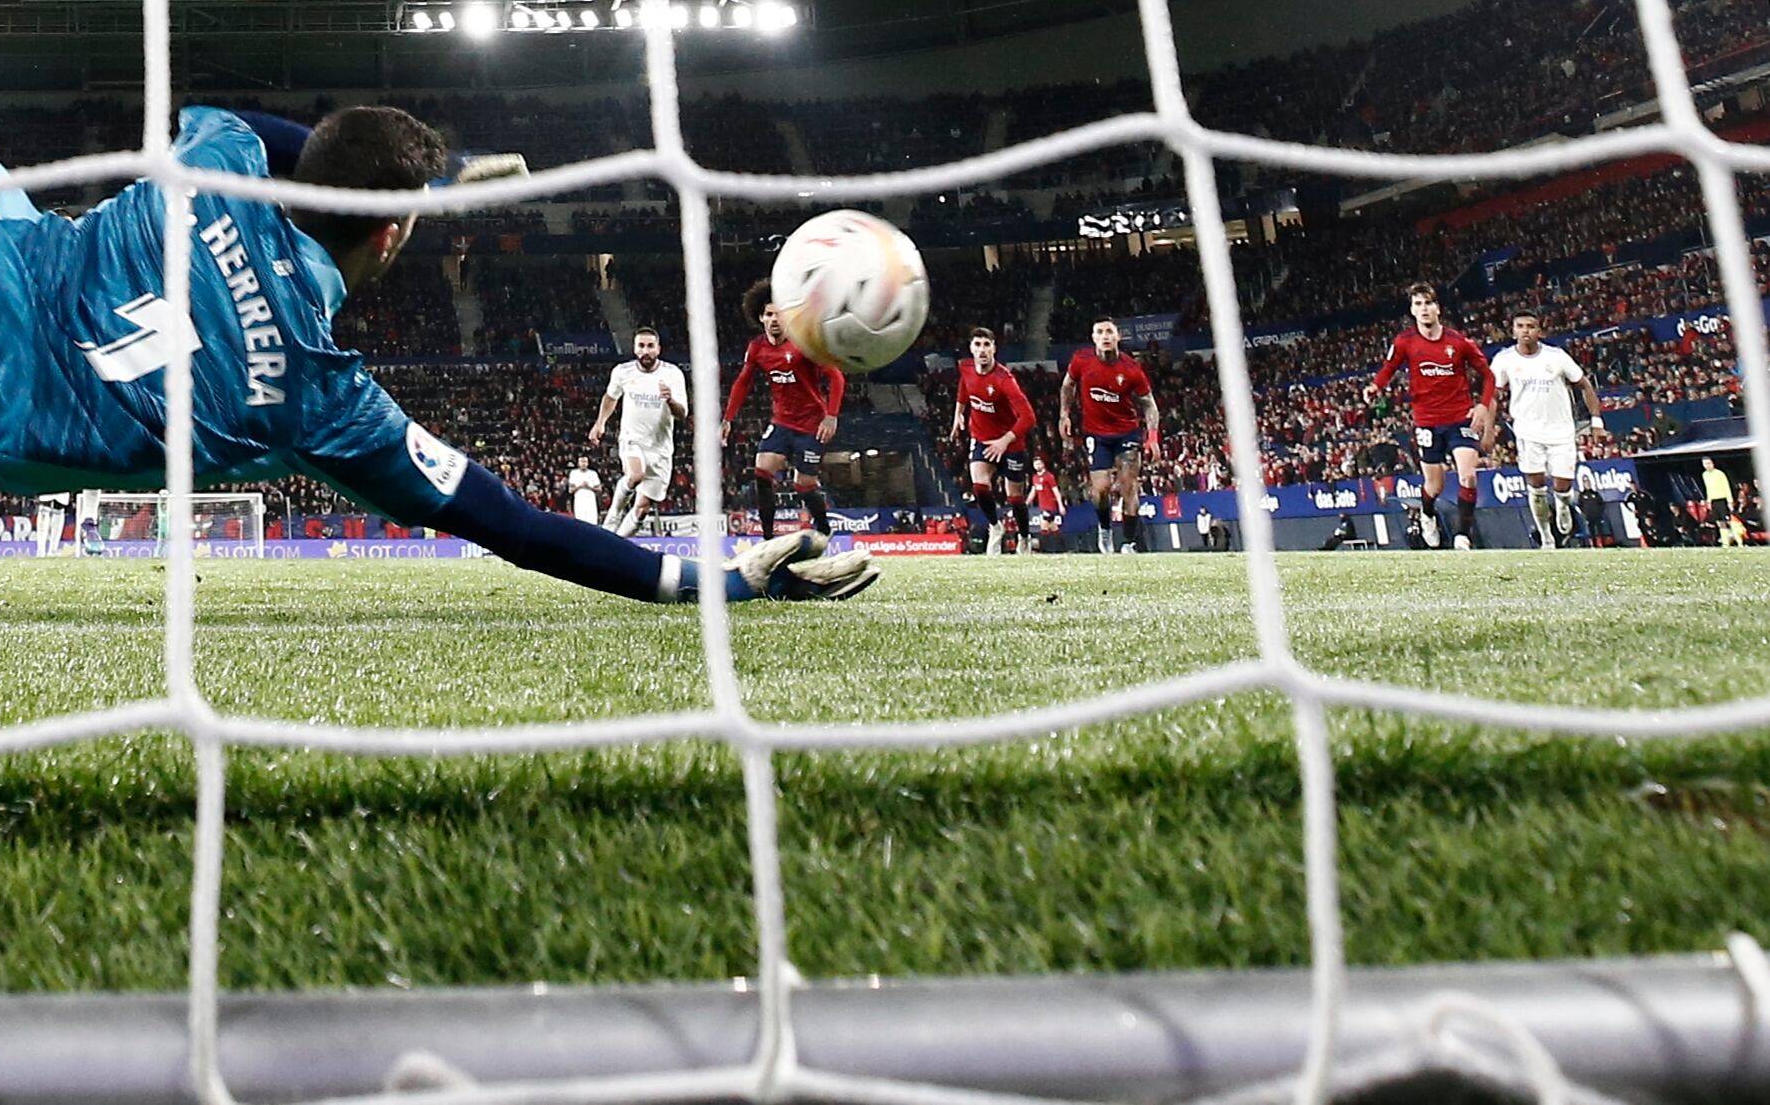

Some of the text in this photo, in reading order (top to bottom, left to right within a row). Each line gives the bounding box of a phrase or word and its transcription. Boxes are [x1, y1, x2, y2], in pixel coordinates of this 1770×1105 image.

[199, 213, 287, 407] HERRERA
[1085, 436, 1095, 454] 9
[1416, 428, 1433, 447] 28
[215, 546, 301, 559] SLOTCOM
[350, 546, 437, 559] SLOT.COM
[906, 540, 958, 552] Santander
